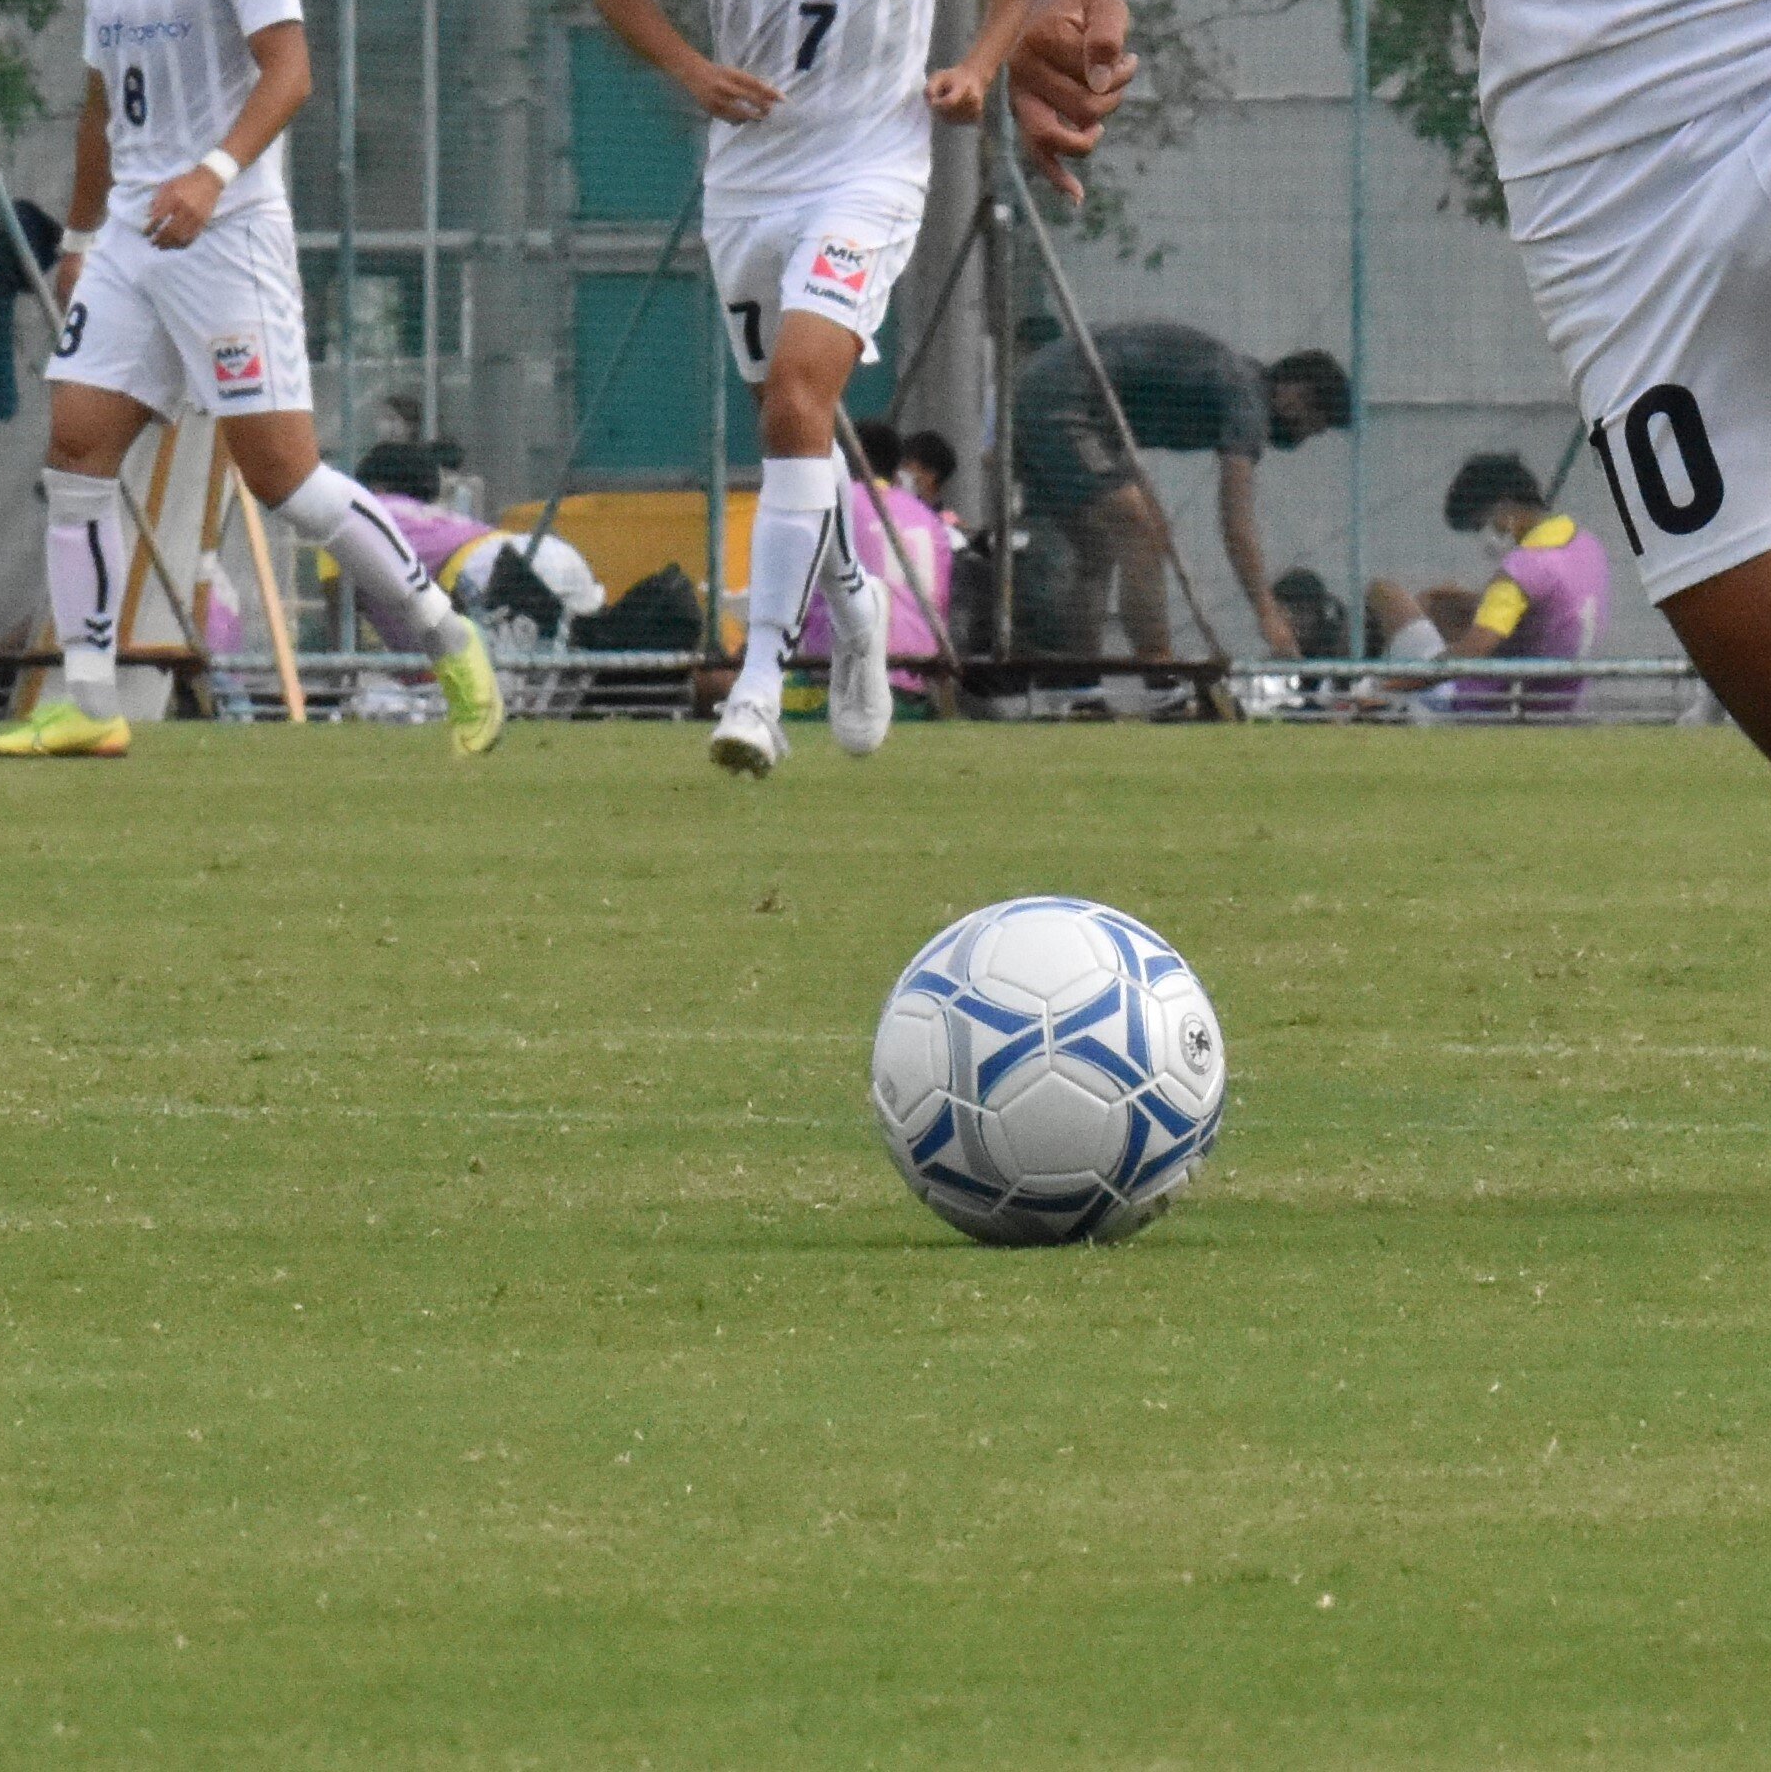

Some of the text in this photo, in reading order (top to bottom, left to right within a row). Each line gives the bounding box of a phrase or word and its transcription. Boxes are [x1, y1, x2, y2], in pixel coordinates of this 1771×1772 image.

[795, 1, 838, 71] 7
[123, 64, 147, 127] 8
[728, 300, 766, 361] 7
[1588, 382, 1725, 556] 10
